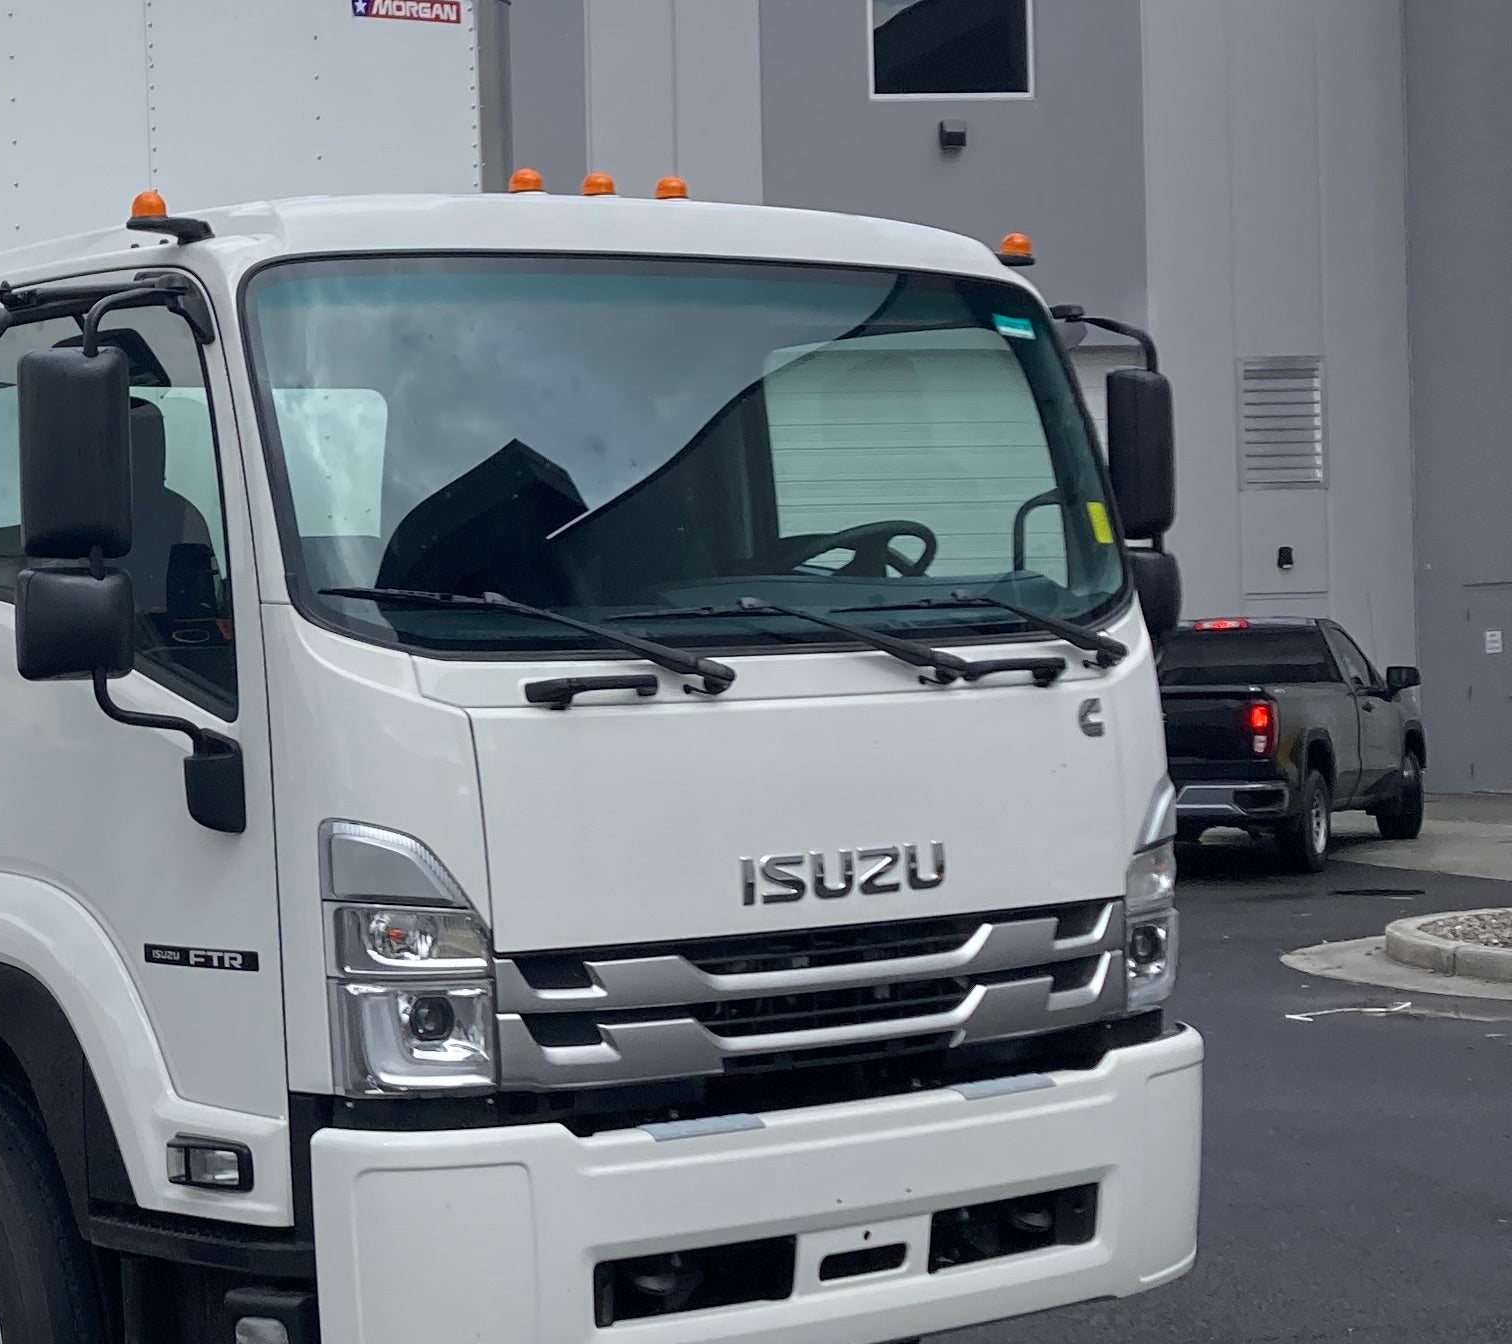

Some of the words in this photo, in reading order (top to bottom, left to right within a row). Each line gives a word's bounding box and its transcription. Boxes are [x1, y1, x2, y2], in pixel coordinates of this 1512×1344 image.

[739, 840, 945, 907] ISUZU
[152, 949, 180, 961] ISUZU
[189, 949, 243, 968] FTR
